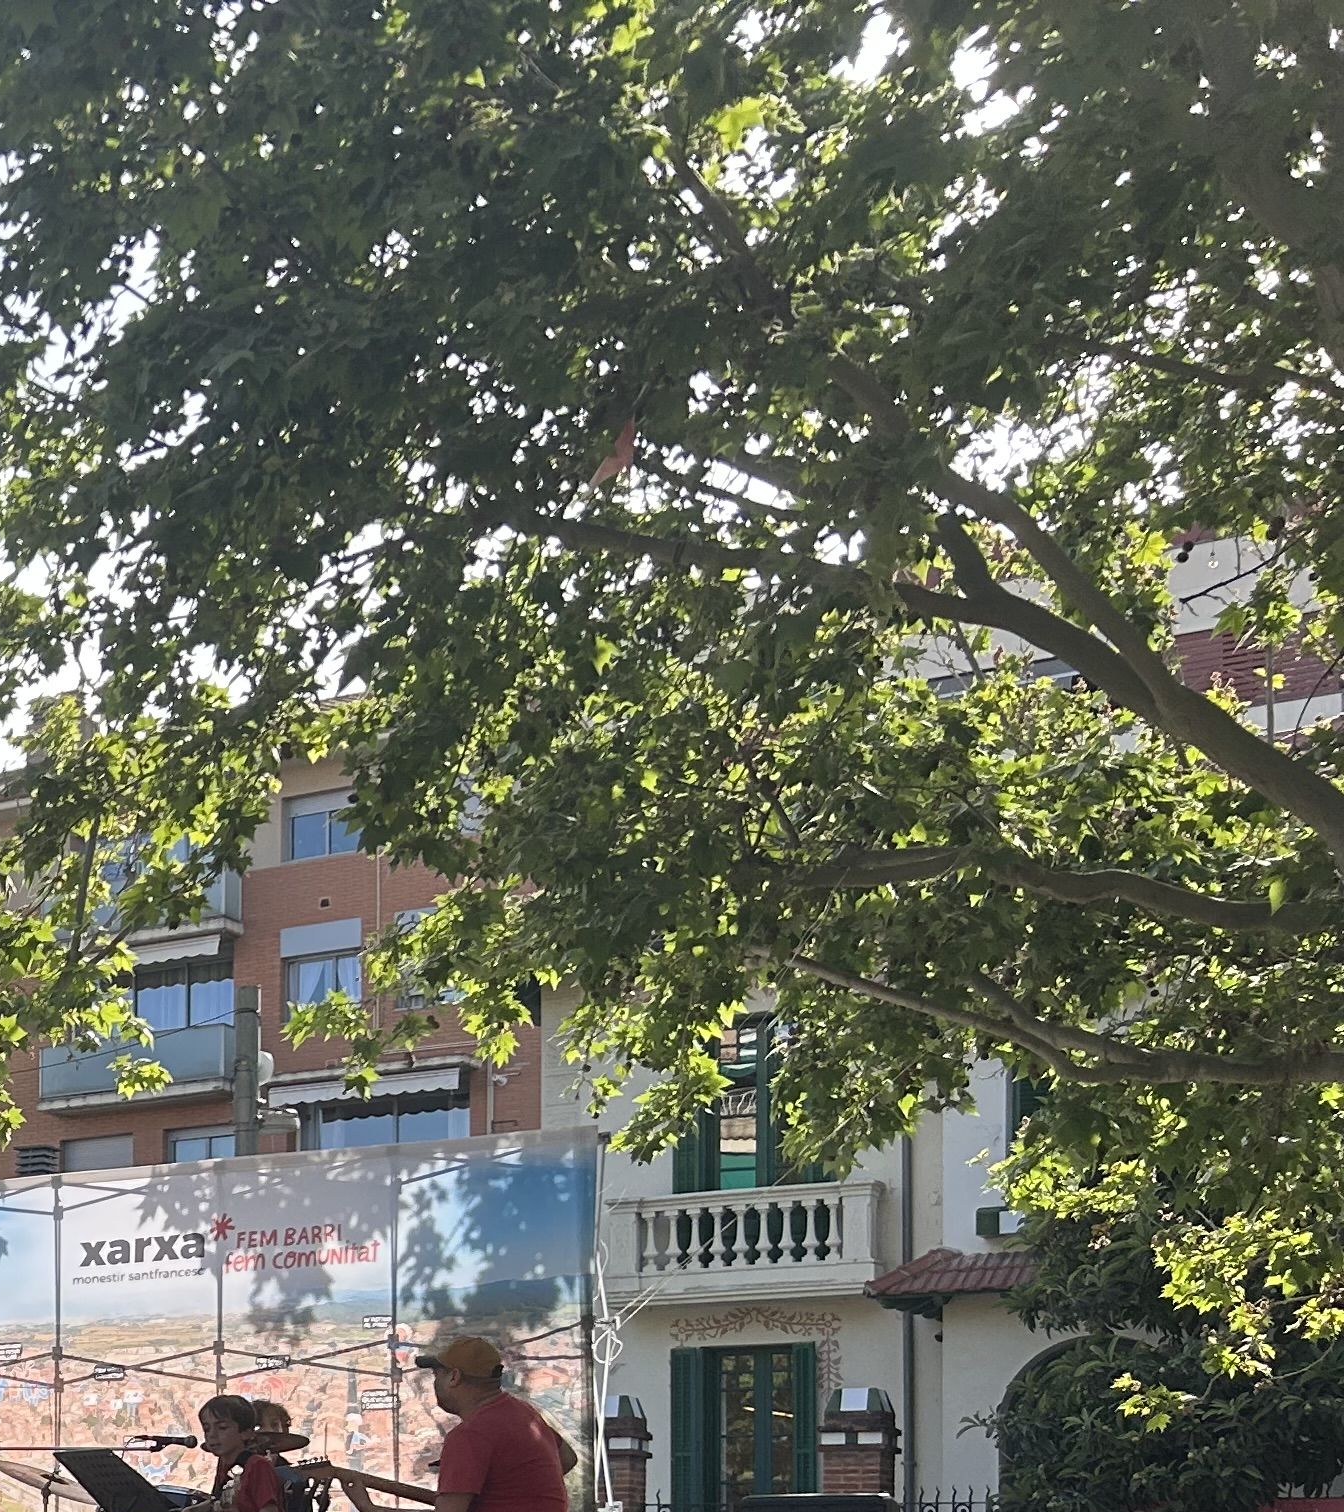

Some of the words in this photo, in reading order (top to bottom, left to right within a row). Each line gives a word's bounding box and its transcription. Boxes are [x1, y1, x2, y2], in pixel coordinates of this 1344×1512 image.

[236, 1229, 277, 1249] FEM
[283, 1223, 343, 1246] BARRI
[80, 1232, 205, 1267] xarxa
[224, 1251, 265, 1274] fem
[72, 1273, 125, 1286] monestir
[128, 1266, 206, 1281] santfrancesc
